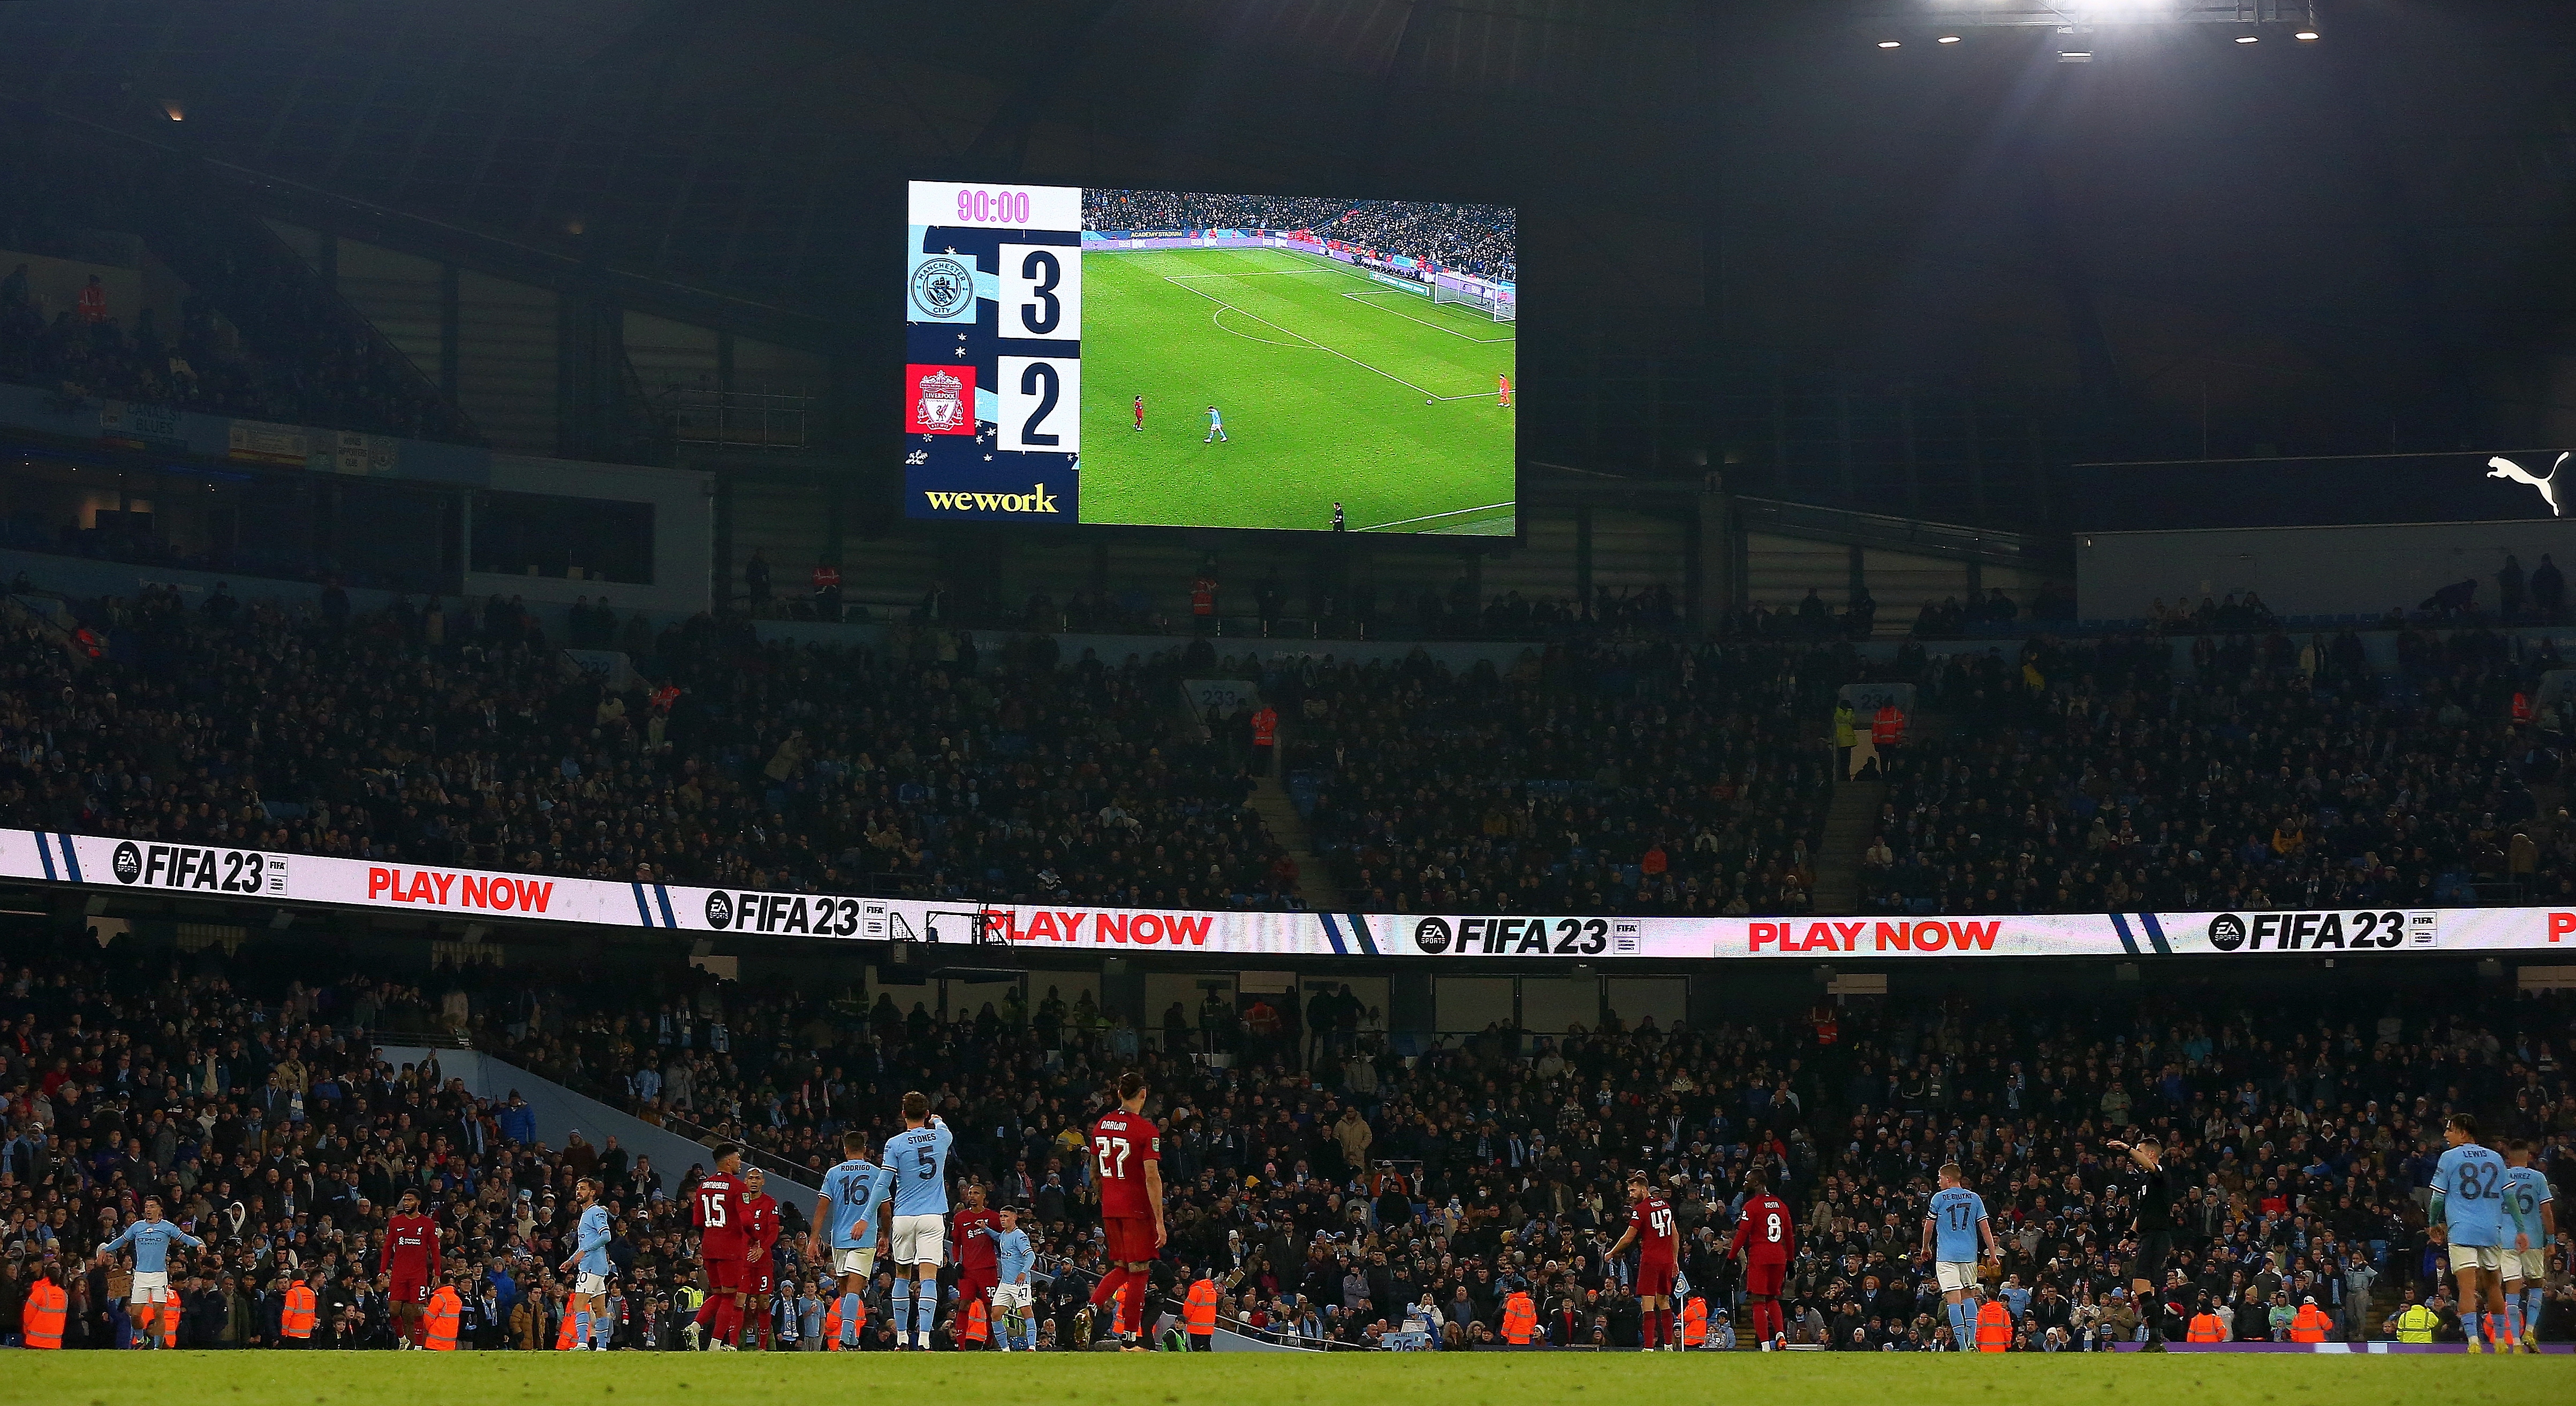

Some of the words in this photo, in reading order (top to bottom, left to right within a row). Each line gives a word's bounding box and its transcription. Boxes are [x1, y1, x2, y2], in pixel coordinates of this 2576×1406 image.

[958, 191, 1029, 223] 90:00
[918, 263, 966, 281] MANCHESTER
[1021, 251, 1060, 334] 3
[1021, 362, 1059, 446] 2
[137, 418, 173, 434] BLUES
[925, 483, 1059, 513] wework
[1202, 690, 1235, 706] 233
[117, 865, 137, 873] SPORTS
[118, 850, 137, 866] EA
[145, 845, 218, 890] FIFA
[221, 851, 264, 893] 23
[270, 861, 285, 870] FIFA
[368, 867, 456, 905] PLAY
[462, 875, 554, 912] NOW
[710, 898, 728, 913] EA
[735, 893, 809, 934] FIFA
[812, 898, 860, 936] 23
[981, 909, 1088, 942] PLAY
[1096, 913, 1213, 946] NOW
[1421, 925, 1444, 938] EA
[1455, 919, 1549, 954] FIFA
[1554, 919, 1607, 954] 23
[1749, 923, 1866, 952] PLAY
[1875, 921, 2002, 950] NOW
[2215, 921, 2239, 934] EA
[2249, 913, 2344, 949] FIFA
[2350, 912, 2405, 948] 23
[907, 1133, 936, 1144] STONES
[1101, 1121, 1127, 1131] DARWIN
[918, 1145, 936, 1180] 5
[1095, 1137, 1131, 1179] 27
[838, 1175, 869, 1205] 16
[2459, 1162, 2499, 1199] 82
[701, 1194, 725, 1227] 15
[1650, 1208, 1671, 1237] 47
[1946, 1202, 1971, 1231] 17
[1768, 1213, 1781, 1242] 8
[420, 1286, 425, 1297] 2
[761, 1276, 767, 1288] 3
[986, 1287, 996, 1297] 32
[1018, 1287, 1028, 1298] 47
[1392, 1340, 1413, 1351] 26
